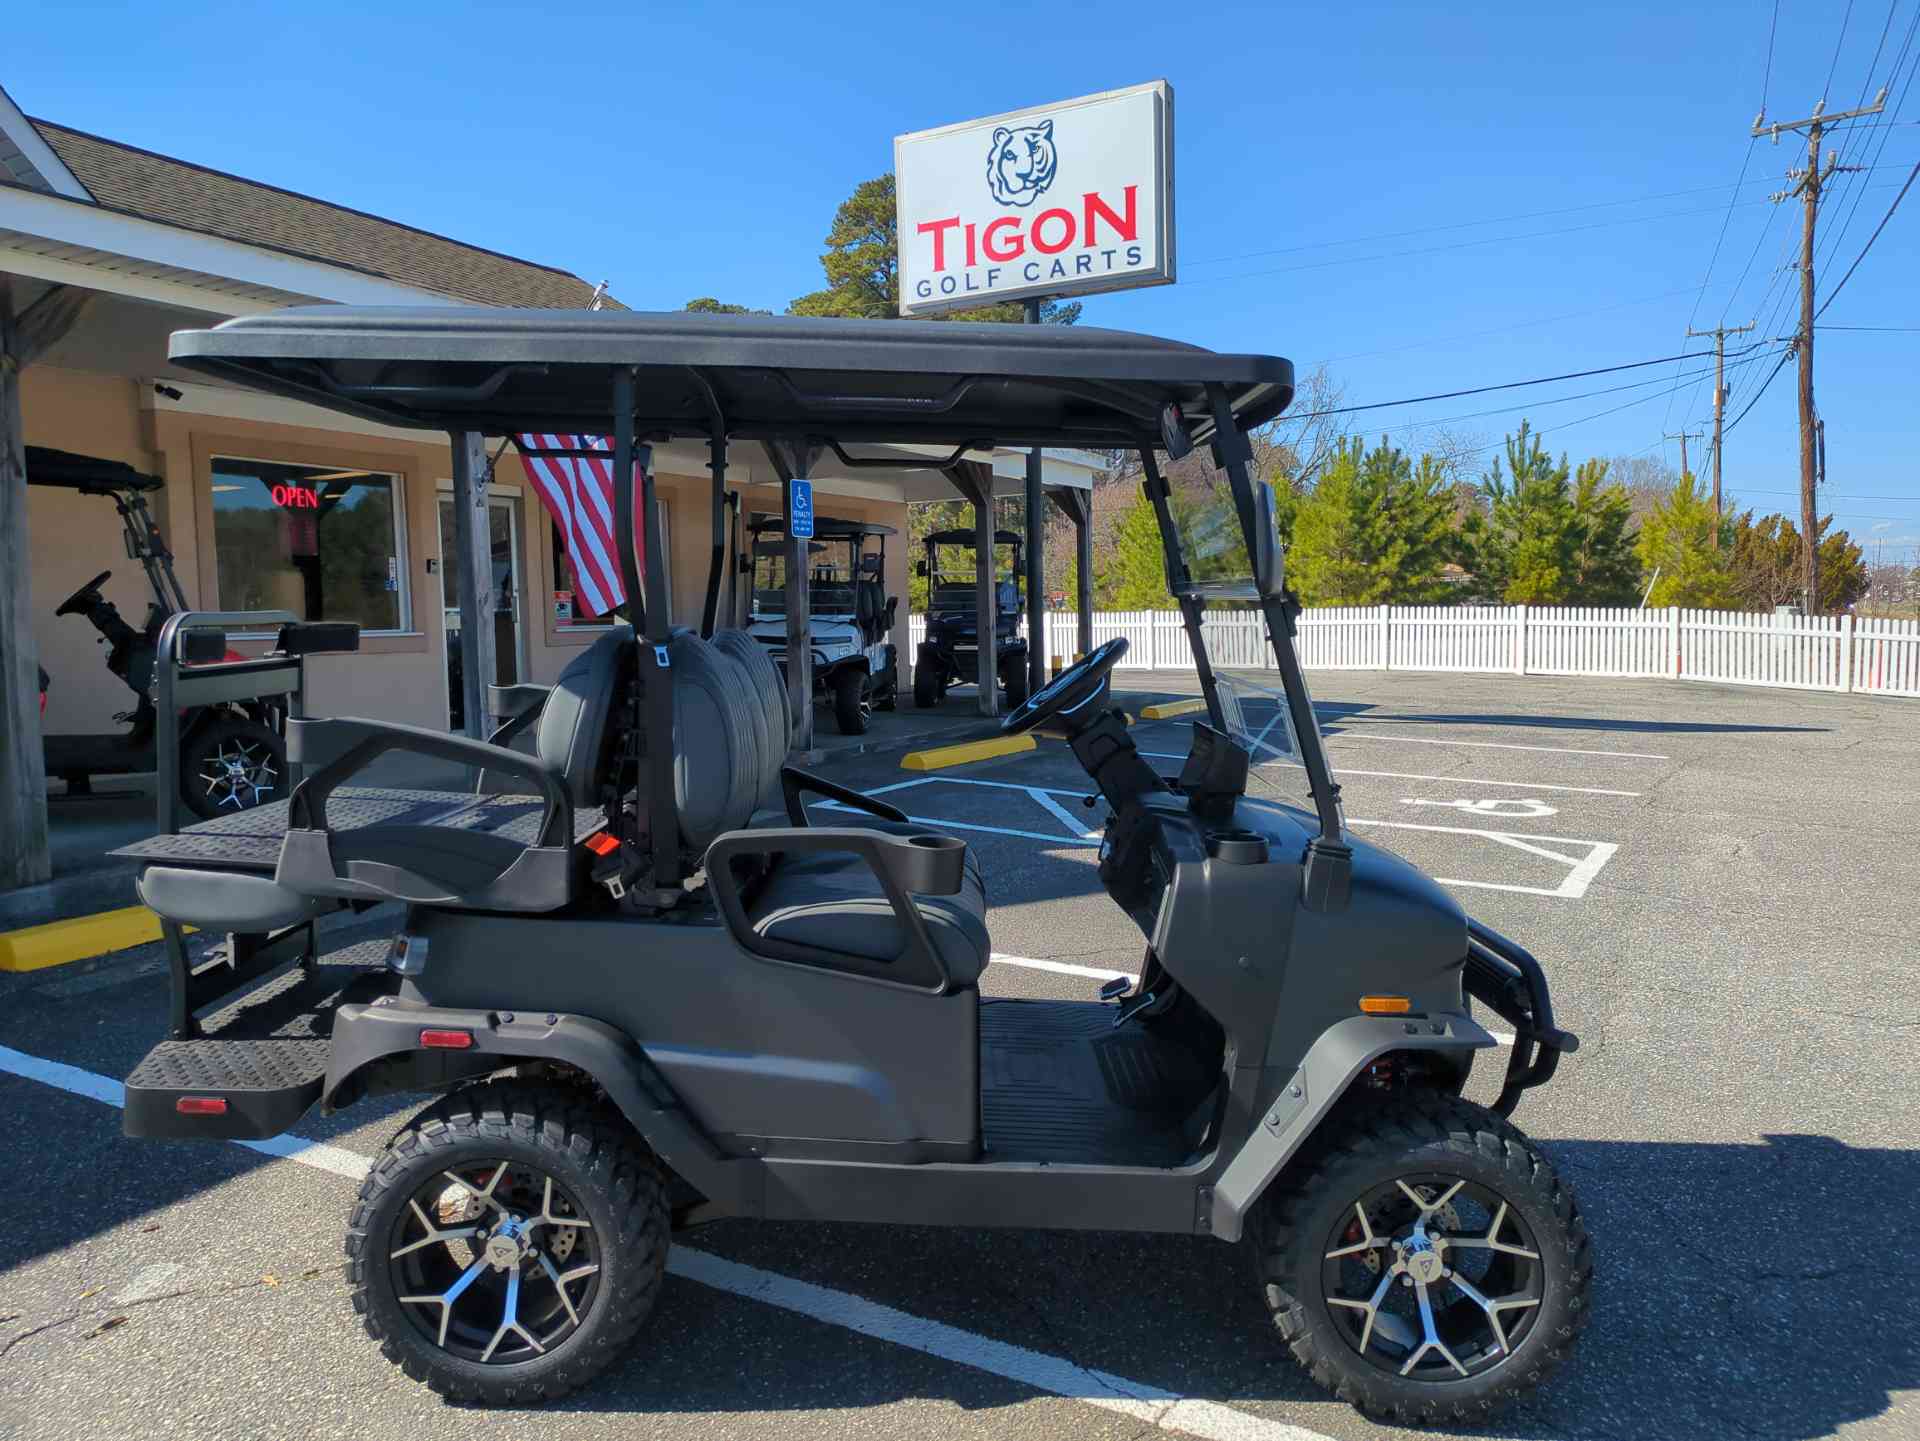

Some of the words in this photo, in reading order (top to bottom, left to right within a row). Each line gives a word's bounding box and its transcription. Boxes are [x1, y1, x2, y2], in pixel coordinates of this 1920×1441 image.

[917, 185, 1138, 272] TIGON
[916, 268, 1001, 297] GOLF
[1023, 246, 1142, 281] CARTS
[272, 485, 319, 508] OPEN
